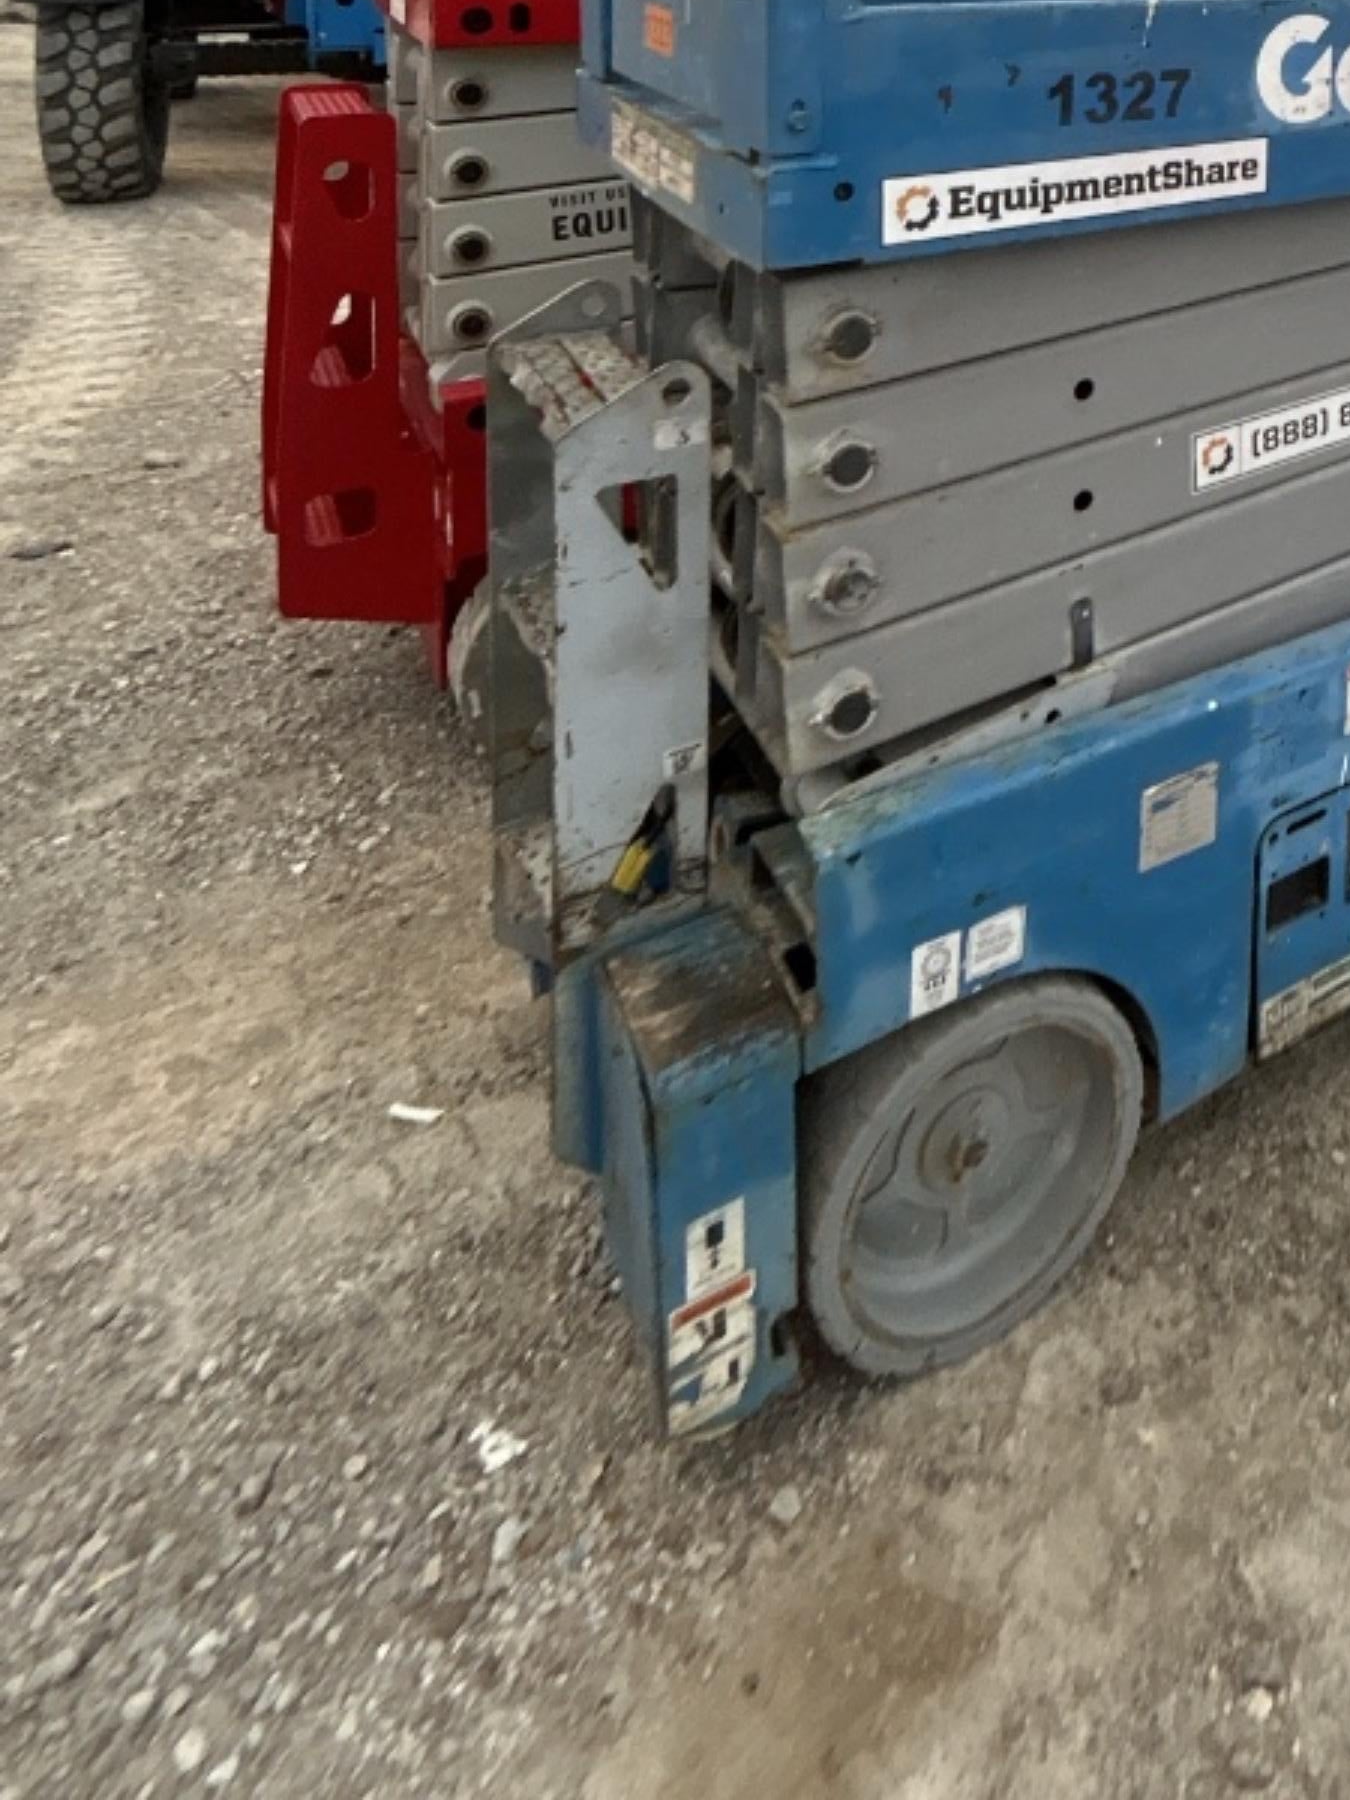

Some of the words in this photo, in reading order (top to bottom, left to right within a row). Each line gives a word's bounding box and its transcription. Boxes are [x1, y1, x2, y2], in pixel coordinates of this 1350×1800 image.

[1049, 68, 1192, 127] 1327
[948, 155, 1259, 221] EquipmentShare
[1252, 407, 1329, 457] (888)
